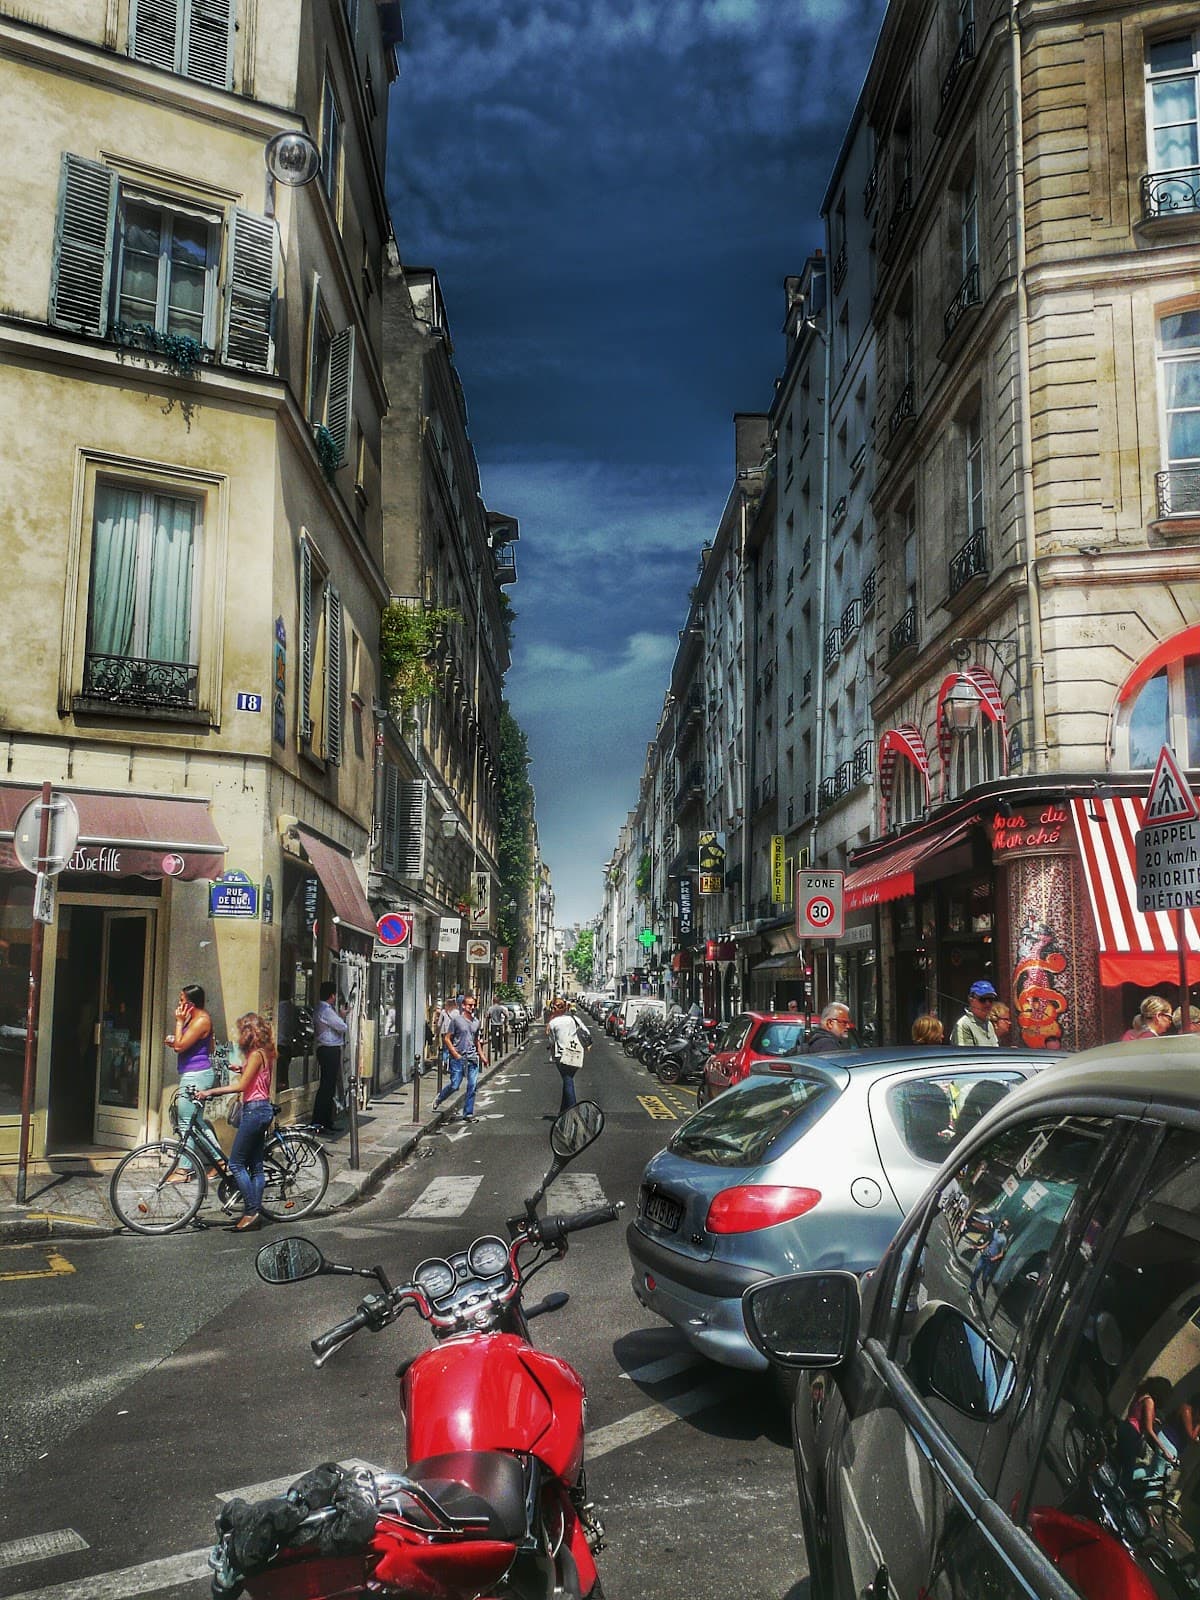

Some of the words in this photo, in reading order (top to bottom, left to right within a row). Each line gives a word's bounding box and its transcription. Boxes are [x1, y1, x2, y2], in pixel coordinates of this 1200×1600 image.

[241, 694, 257, 711] 18
[1040, 804, 1068, 823] du
[992, 825, 1061, 849] Marché
[1144, 824, 1196, 847] RAPPEL
[1145, 851, 1161, 868] 20
[1167, 846, 1198, 865] km/h
[226, 888, 243, 896] RUE
[807, 879, 836, 888] ZONE
[218, 896, 229, 904] DE
[231, 896, 250, 905] BUCI
[680, 880, 690, 934] PRESSING
[812, 905, 829, 919] 30
